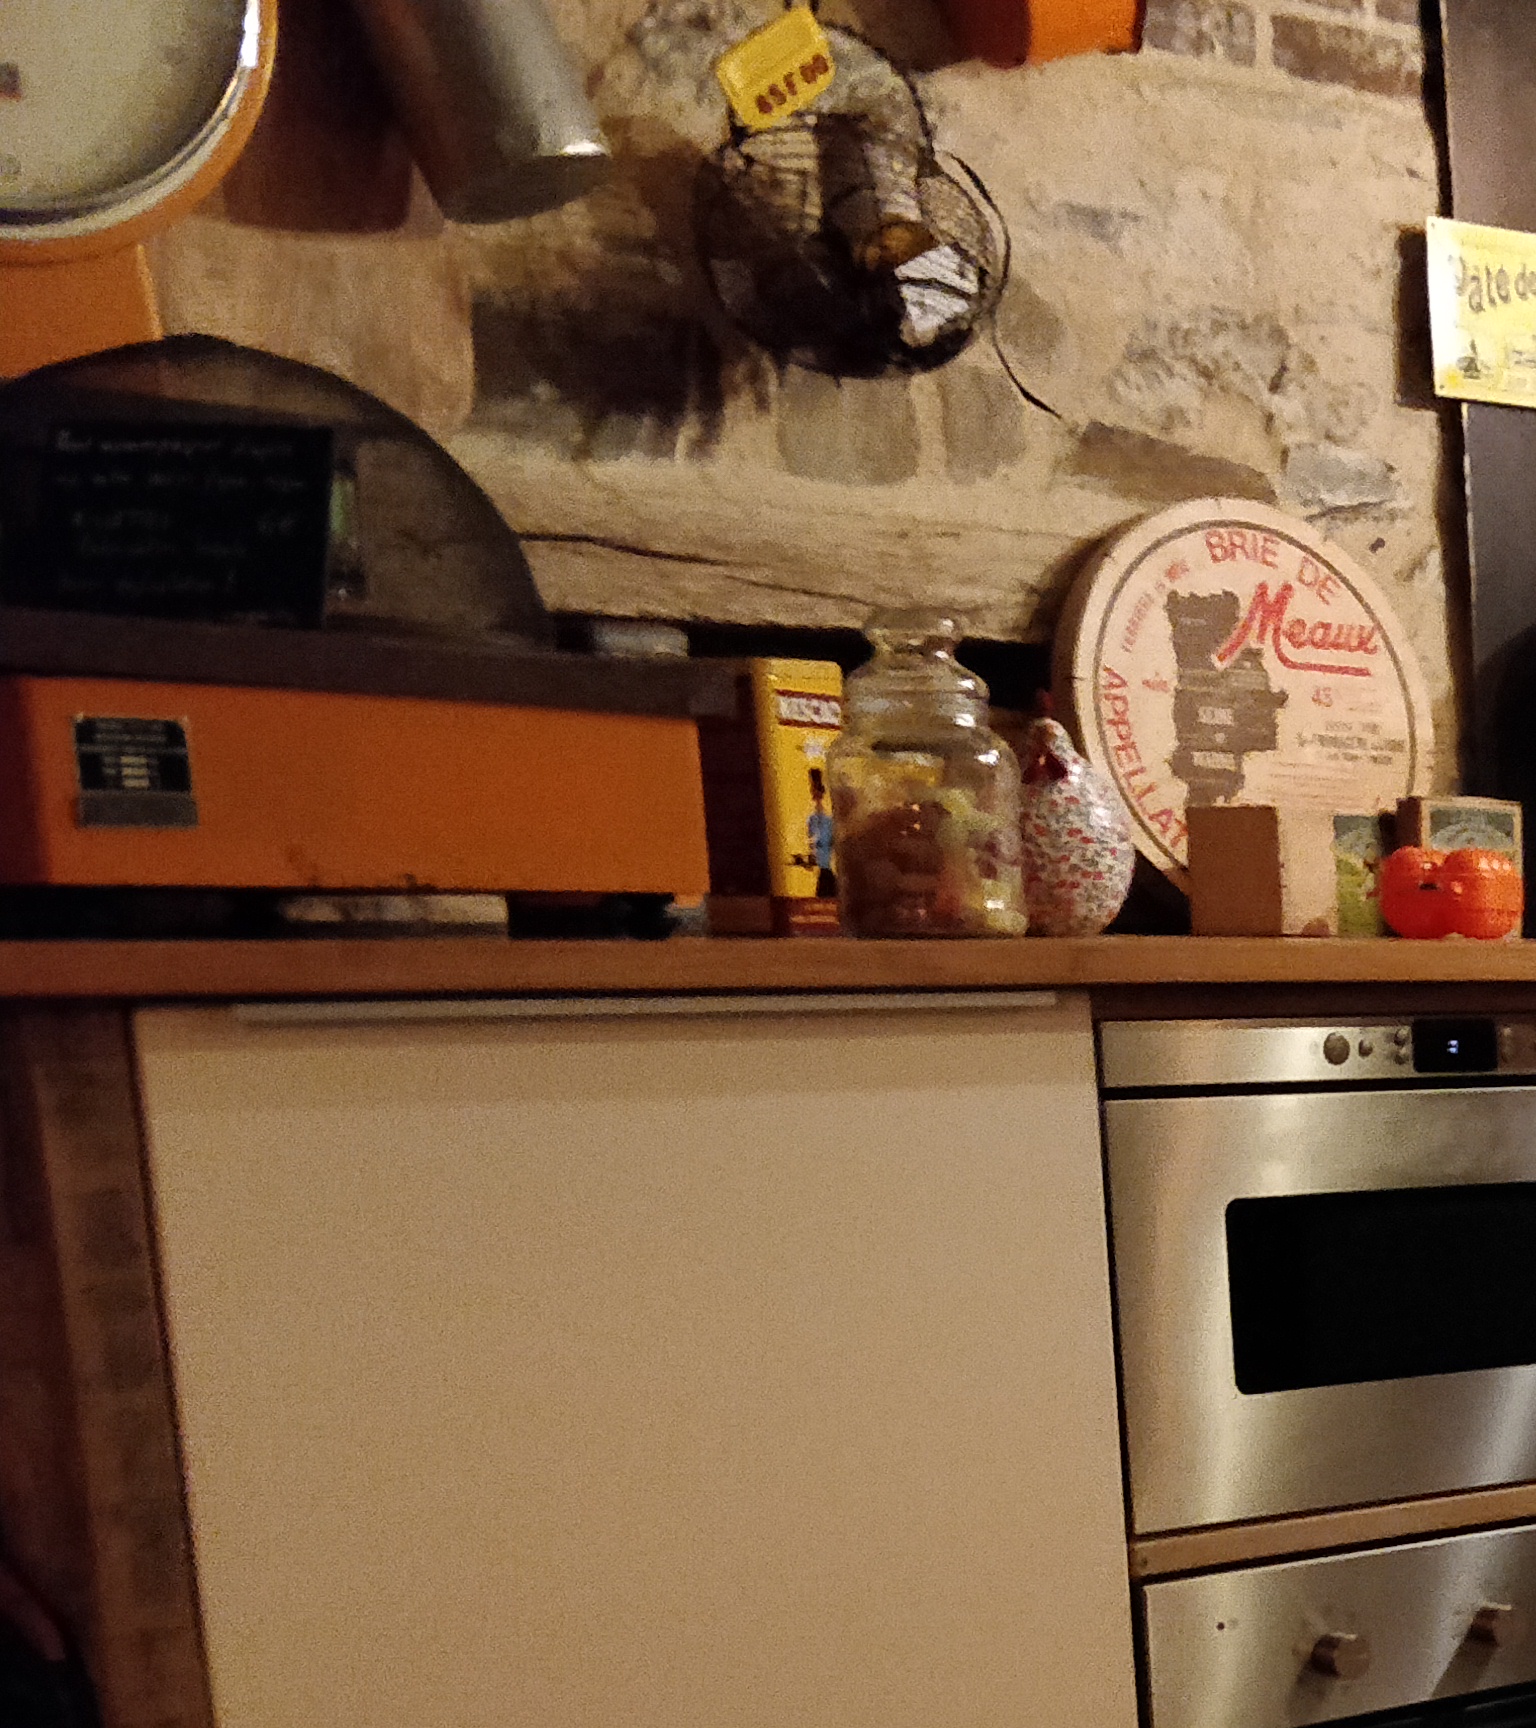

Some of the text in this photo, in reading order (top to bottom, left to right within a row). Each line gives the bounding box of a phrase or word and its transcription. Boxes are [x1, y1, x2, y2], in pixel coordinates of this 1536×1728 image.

[1205, 528, 1341, 606] BRIE DE
[1215, 580, 1379, 677] Meaux
